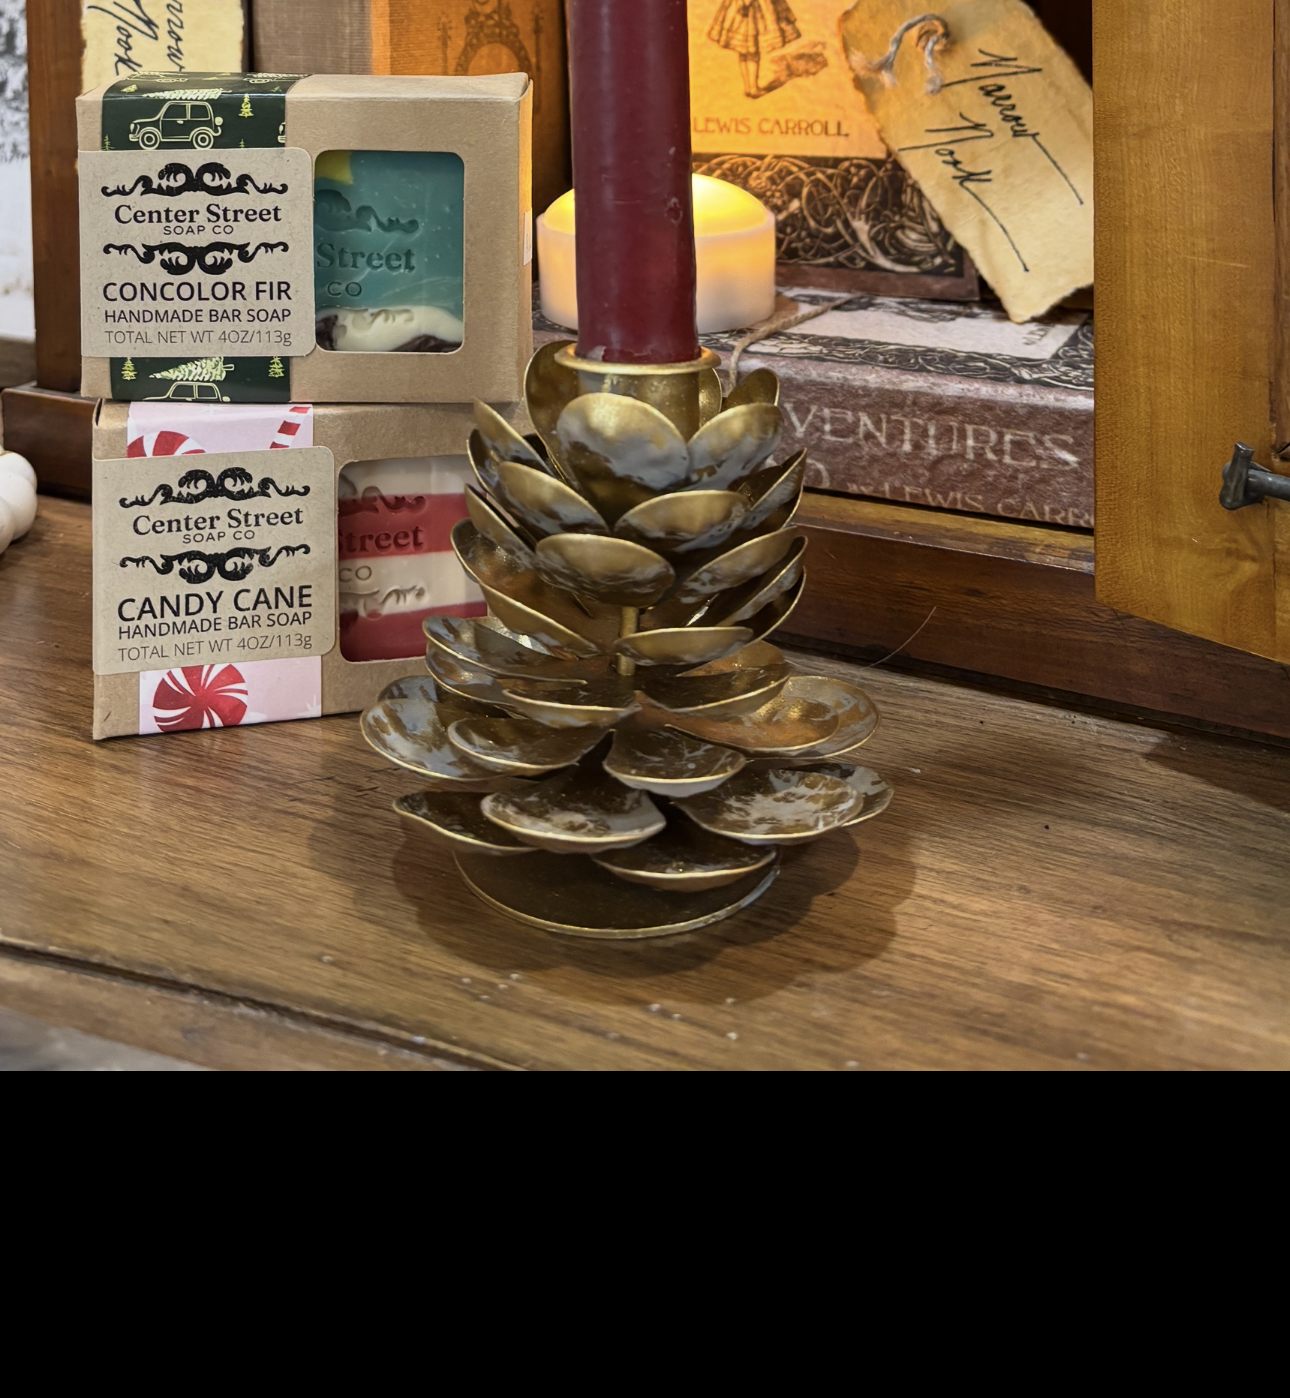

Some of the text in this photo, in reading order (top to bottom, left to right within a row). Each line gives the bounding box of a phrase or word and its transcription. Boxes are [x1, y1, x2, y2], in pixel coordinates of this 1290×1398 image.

[693, 117, 752, 134] LEWIS
[940, 48, 1084, 205] Narrow
[115, 203, 282, 224] Center Street
[163, 224, 234, 235] SOAP CO
[316, 243, 416, 274] Street
[102, 281, 292, 301] CONCOLOR FIR
[327, 281, 363, 297] CO
[105, 308, 292, 323] HANDMADE BAR SOAP
[105, 331, 153, 344] TOTAL
[157, 331, 186, 344] NET
[190, 330, 214, 344] WT
[783, 403, 1081, 469] VENTURES
[132, 507, 304, 535] Center Street
[182, 529, 255, 544] SOAP CO
[339, 565, 372, 583] CO
[117, 585, 313, 622] CANDY CANE
[118, 611, 313, 640] HANDMADE BAR SOAP
[118, 645, 169, 662] TOTAL
[174, 640, 204, 656] NET
[208, 638, 233, 654] WT
